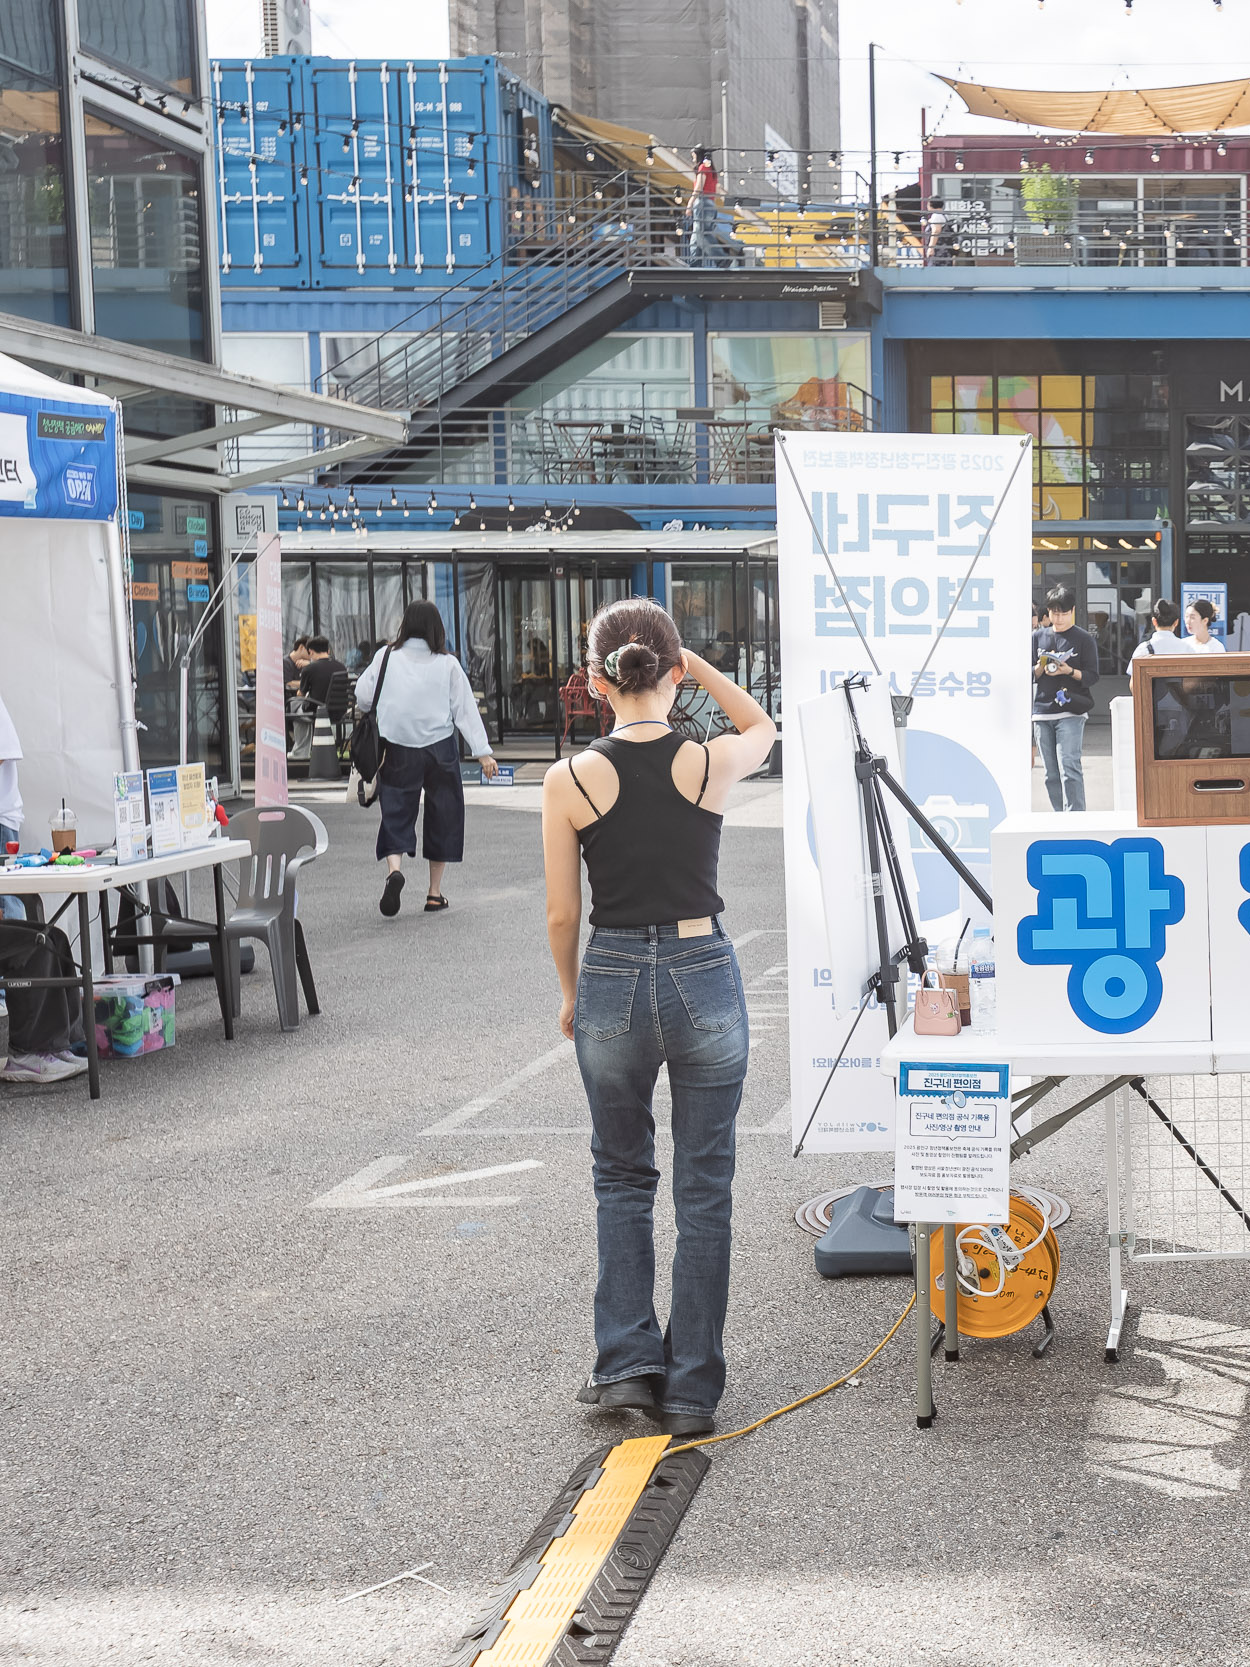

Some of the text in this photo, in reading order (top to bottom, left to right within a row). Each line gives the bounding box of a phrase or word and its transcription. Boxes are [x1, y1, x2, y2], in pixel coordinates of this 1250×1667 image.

[0, 458, 22, 484] 터
[67, 478, 92, 502] OPEN
[923, 1077, 981, 1089] 진구네 편의점
[915, 1112, 934, 1120] 진구네
[936, 1113, 955, 1121] 편의점
